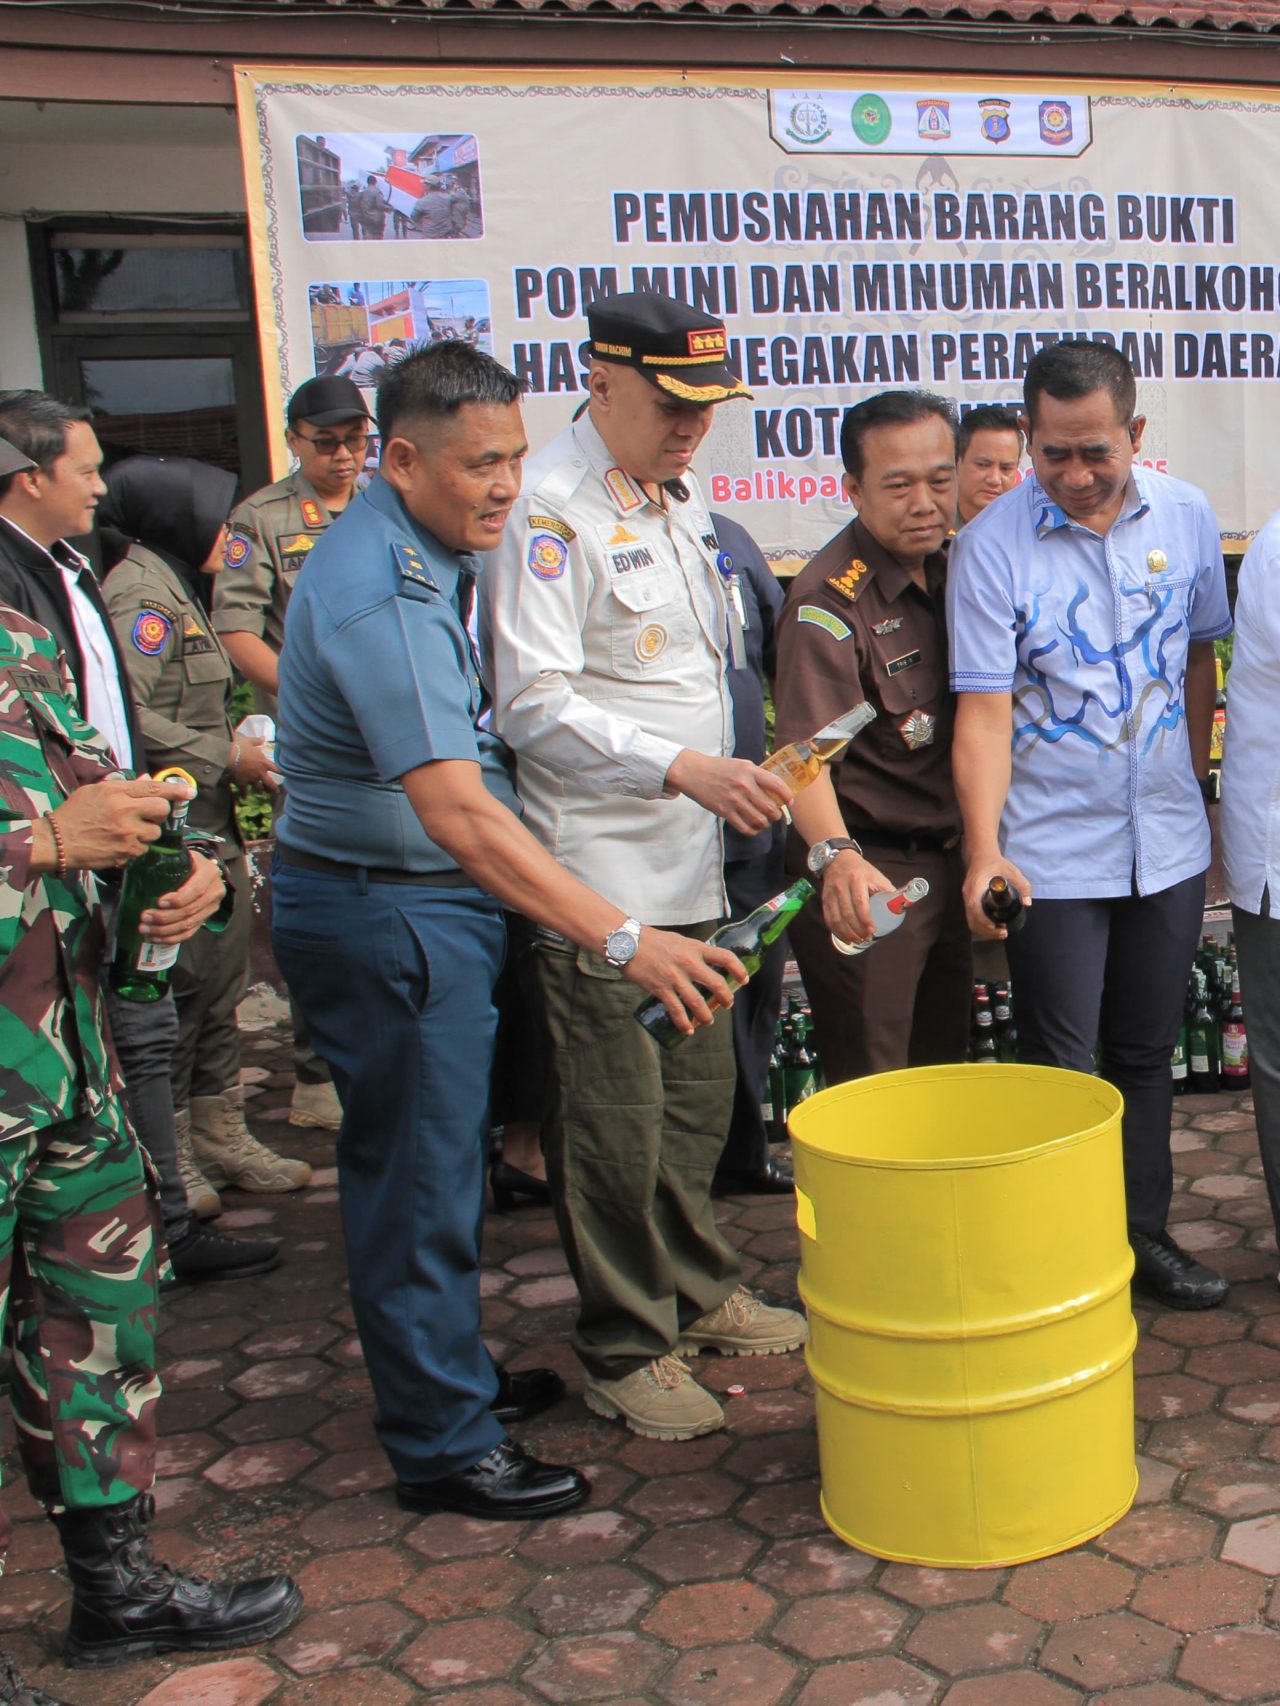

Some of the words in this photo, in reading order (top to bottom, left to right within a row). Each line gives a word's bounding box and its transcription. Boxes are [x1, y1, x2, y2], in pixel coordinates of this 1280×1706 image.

[613, 192, 923, 243] PEMUSNAHAN
[934, 193, 1107, 242] BARANG
[1118, 194, 1235, 244] BUKTI
[514, 266, 618, 318] POM
[750, 264, 841, 314] DAN
[852, 262, 1064, 312] MINUMAN
[725, 334, 920, 387] NEGAKAN
[931, 331, 1163, 381] PERAAN
[754, 407, 851, 459] KOT
[828, 577, 856, 599] JAKSA
